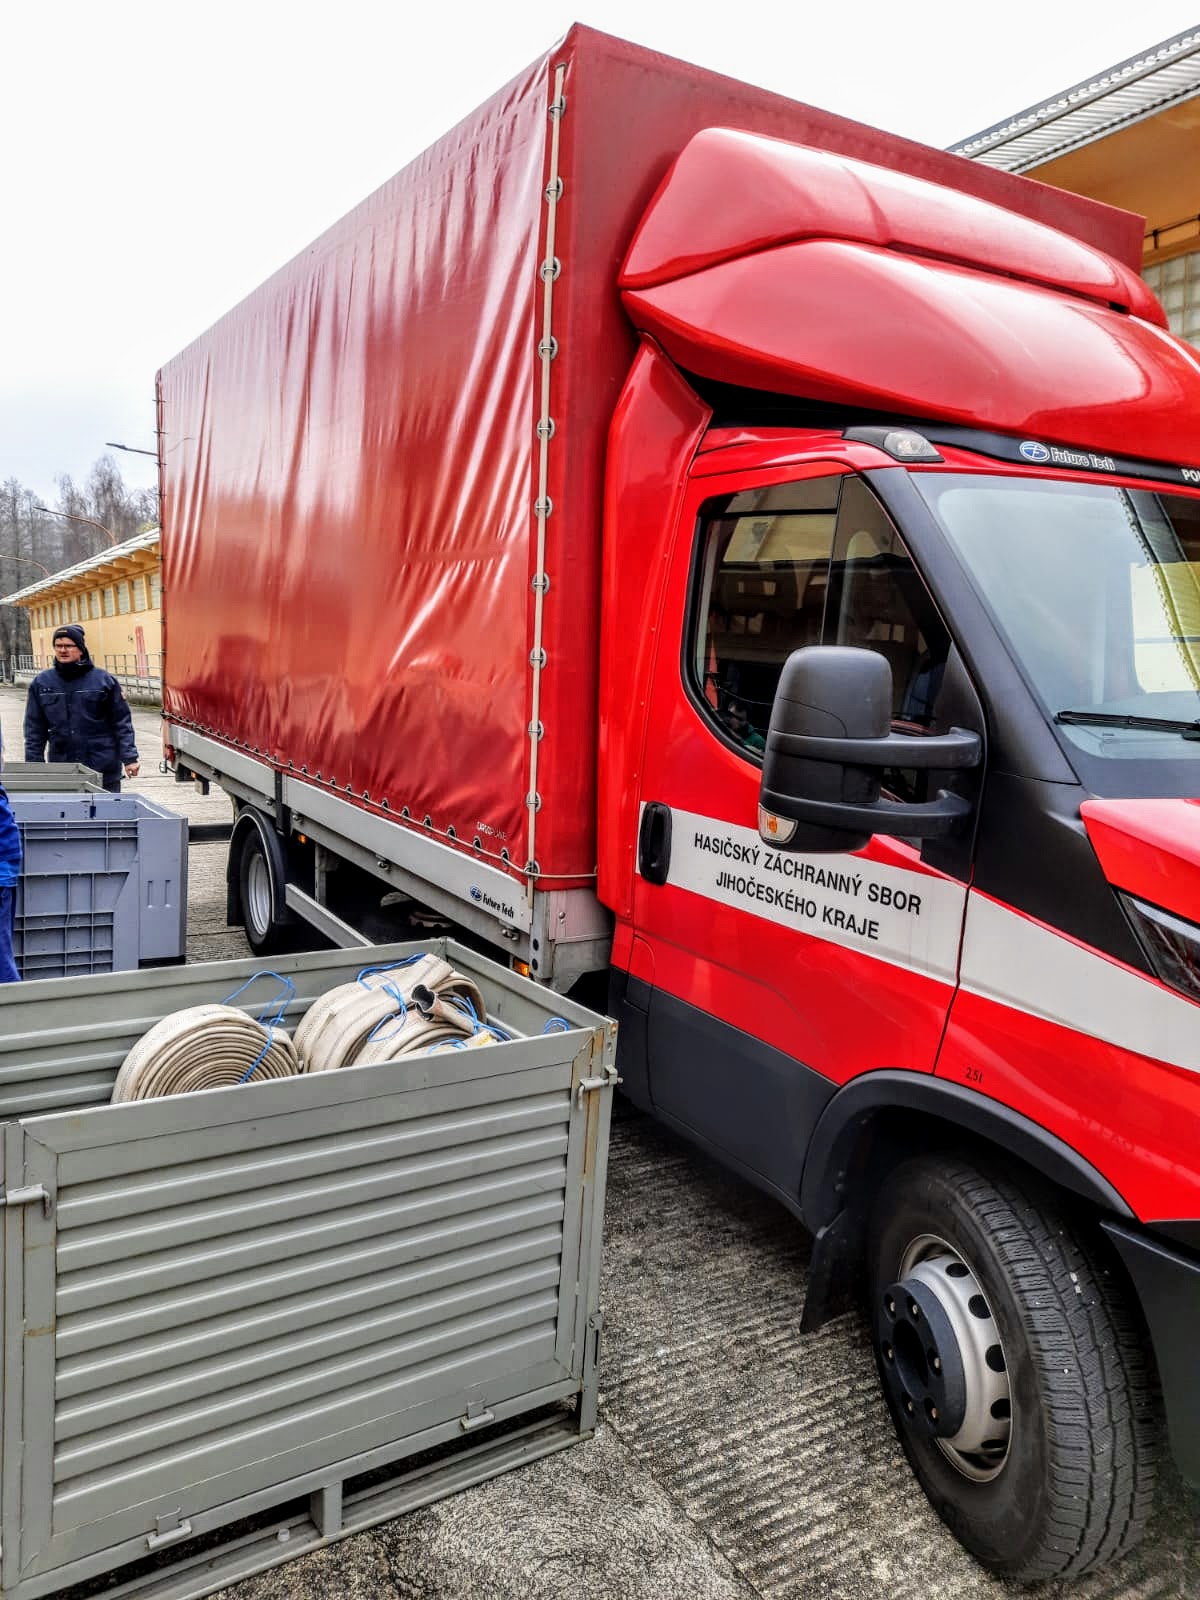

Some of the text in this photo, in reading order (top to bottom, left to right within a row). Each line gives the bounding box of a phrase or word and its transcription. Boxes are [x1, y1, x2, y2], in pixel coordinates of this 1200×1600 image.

[1050, 446, 1116, 471] Future Tech
[1181, 468, 1200, 482] PO
[694, 832, 922, 915] HASIČSKÝ ZÁCHRANNÝ SBOR
[482, 892, 514, 919] Future Tech
[715, 871, 880, 940] JIHOČESKÉHO KRAJE
